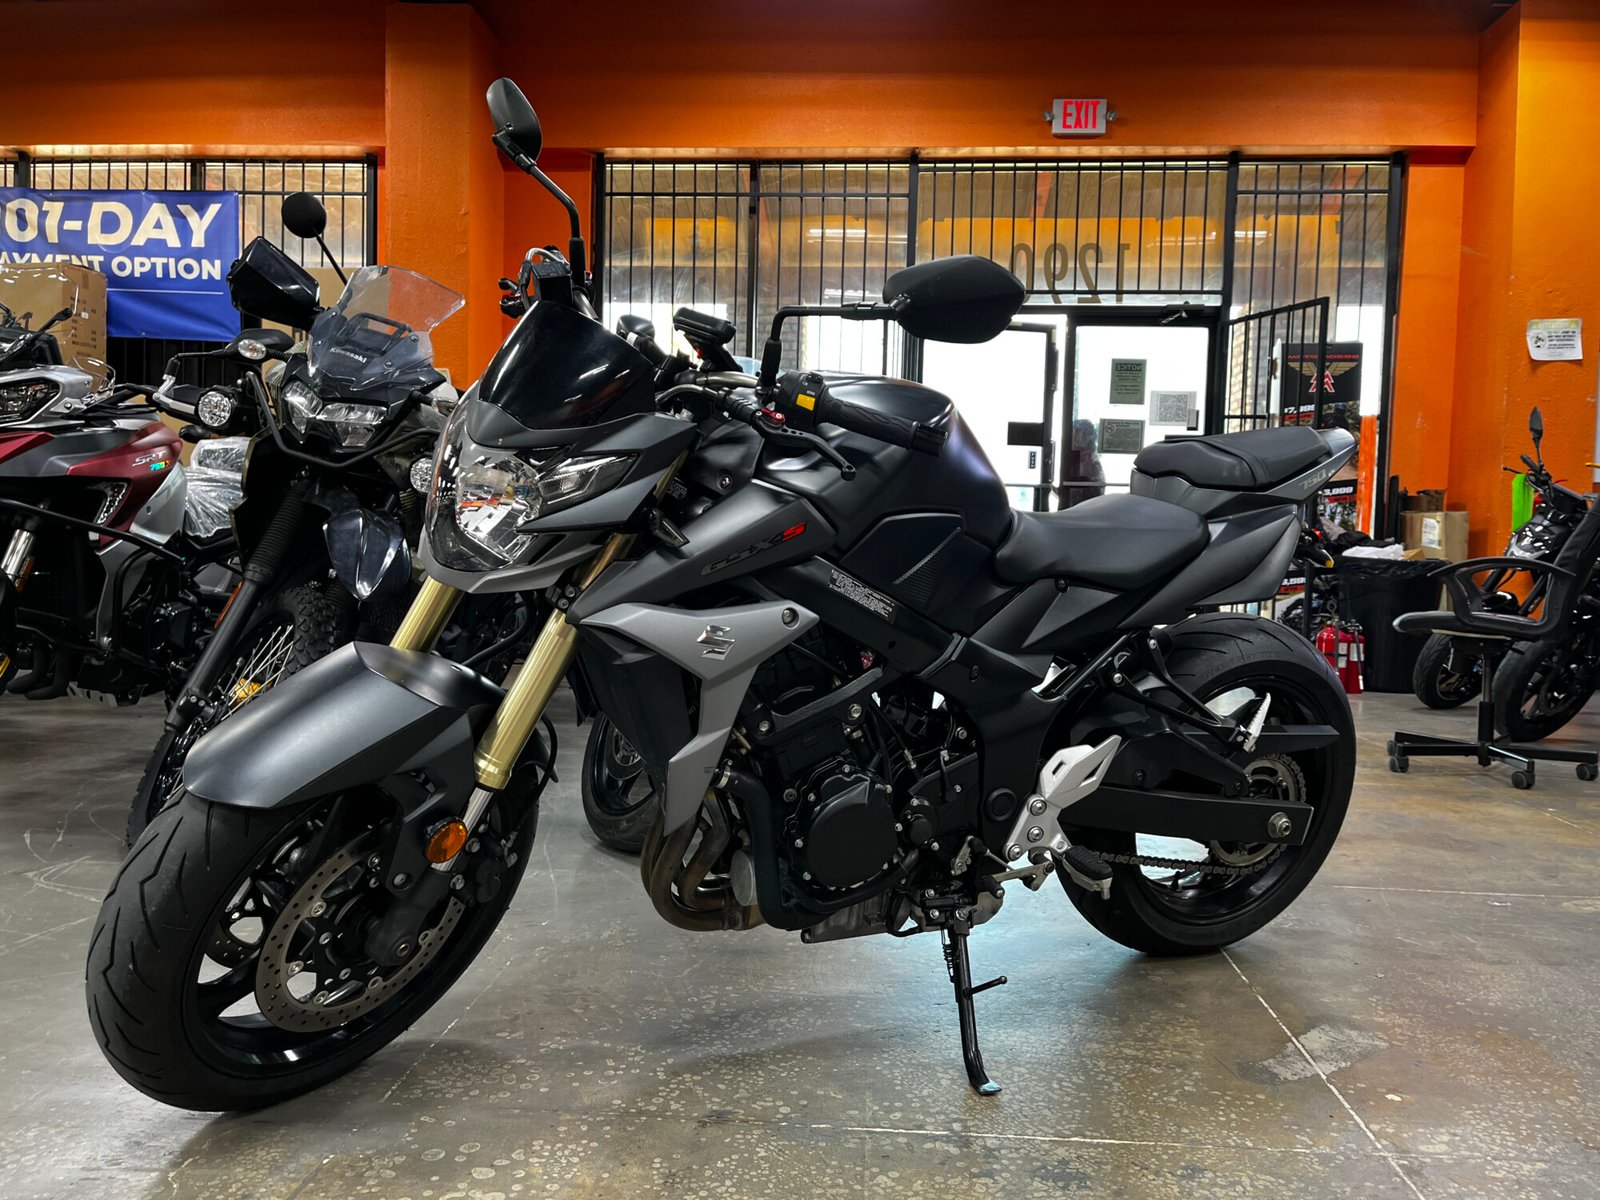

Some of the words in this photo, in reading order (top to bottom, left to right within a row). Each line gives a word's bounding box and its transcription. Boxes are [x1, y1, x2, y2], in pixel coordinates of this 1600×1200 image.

[1062, 100, 1100, 129] EXIT
[0, 198, 222, 248] 01-DAY
[111, 256, 221, 280] OPTION
[330, 347, 367, 363] Kawasaki
[132, 450, 167, 467] SRT
[1298, 468, 1327, 490] 750
[701, 521, 807, 576] GSX-S
